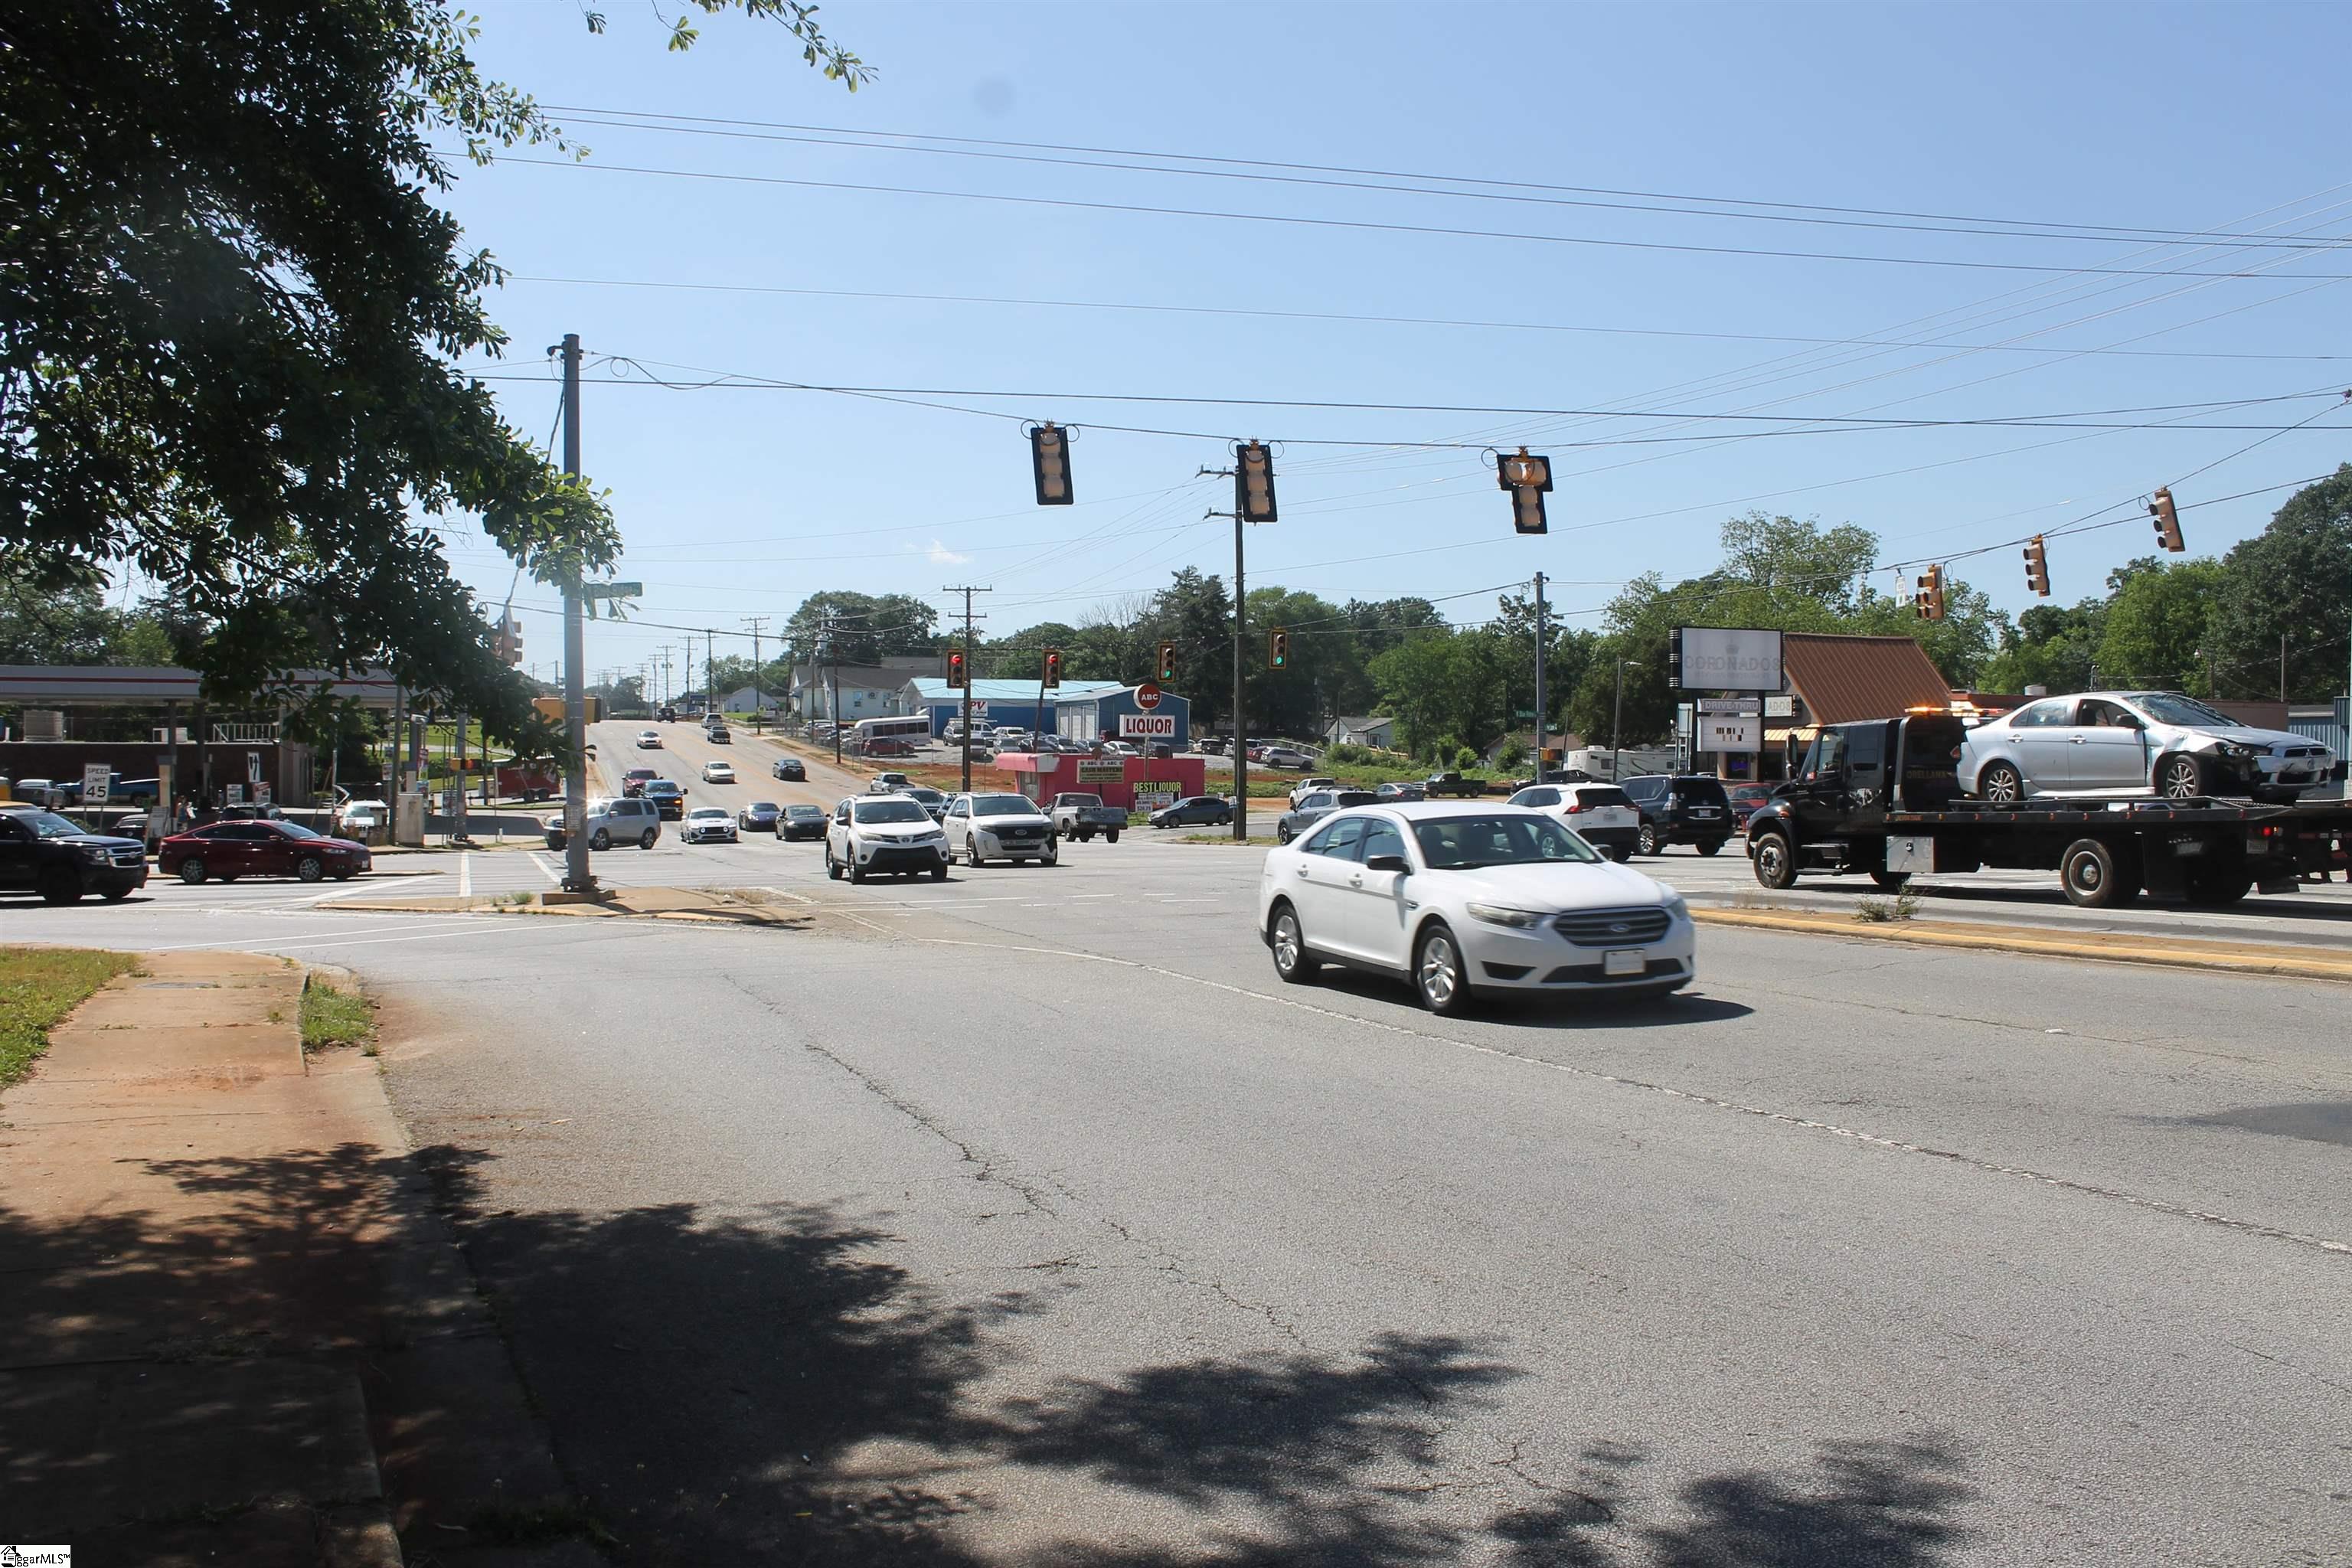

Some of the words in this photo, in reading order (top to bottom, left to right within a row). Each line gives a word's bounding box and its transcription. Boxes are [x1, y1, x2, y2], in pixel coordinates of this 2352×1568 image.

[1704, 701, 1759, 710] DRIVE-THRU
[1126, 718, 1172, 734] LIQUOR
[86, 785, 107, 798] 45
